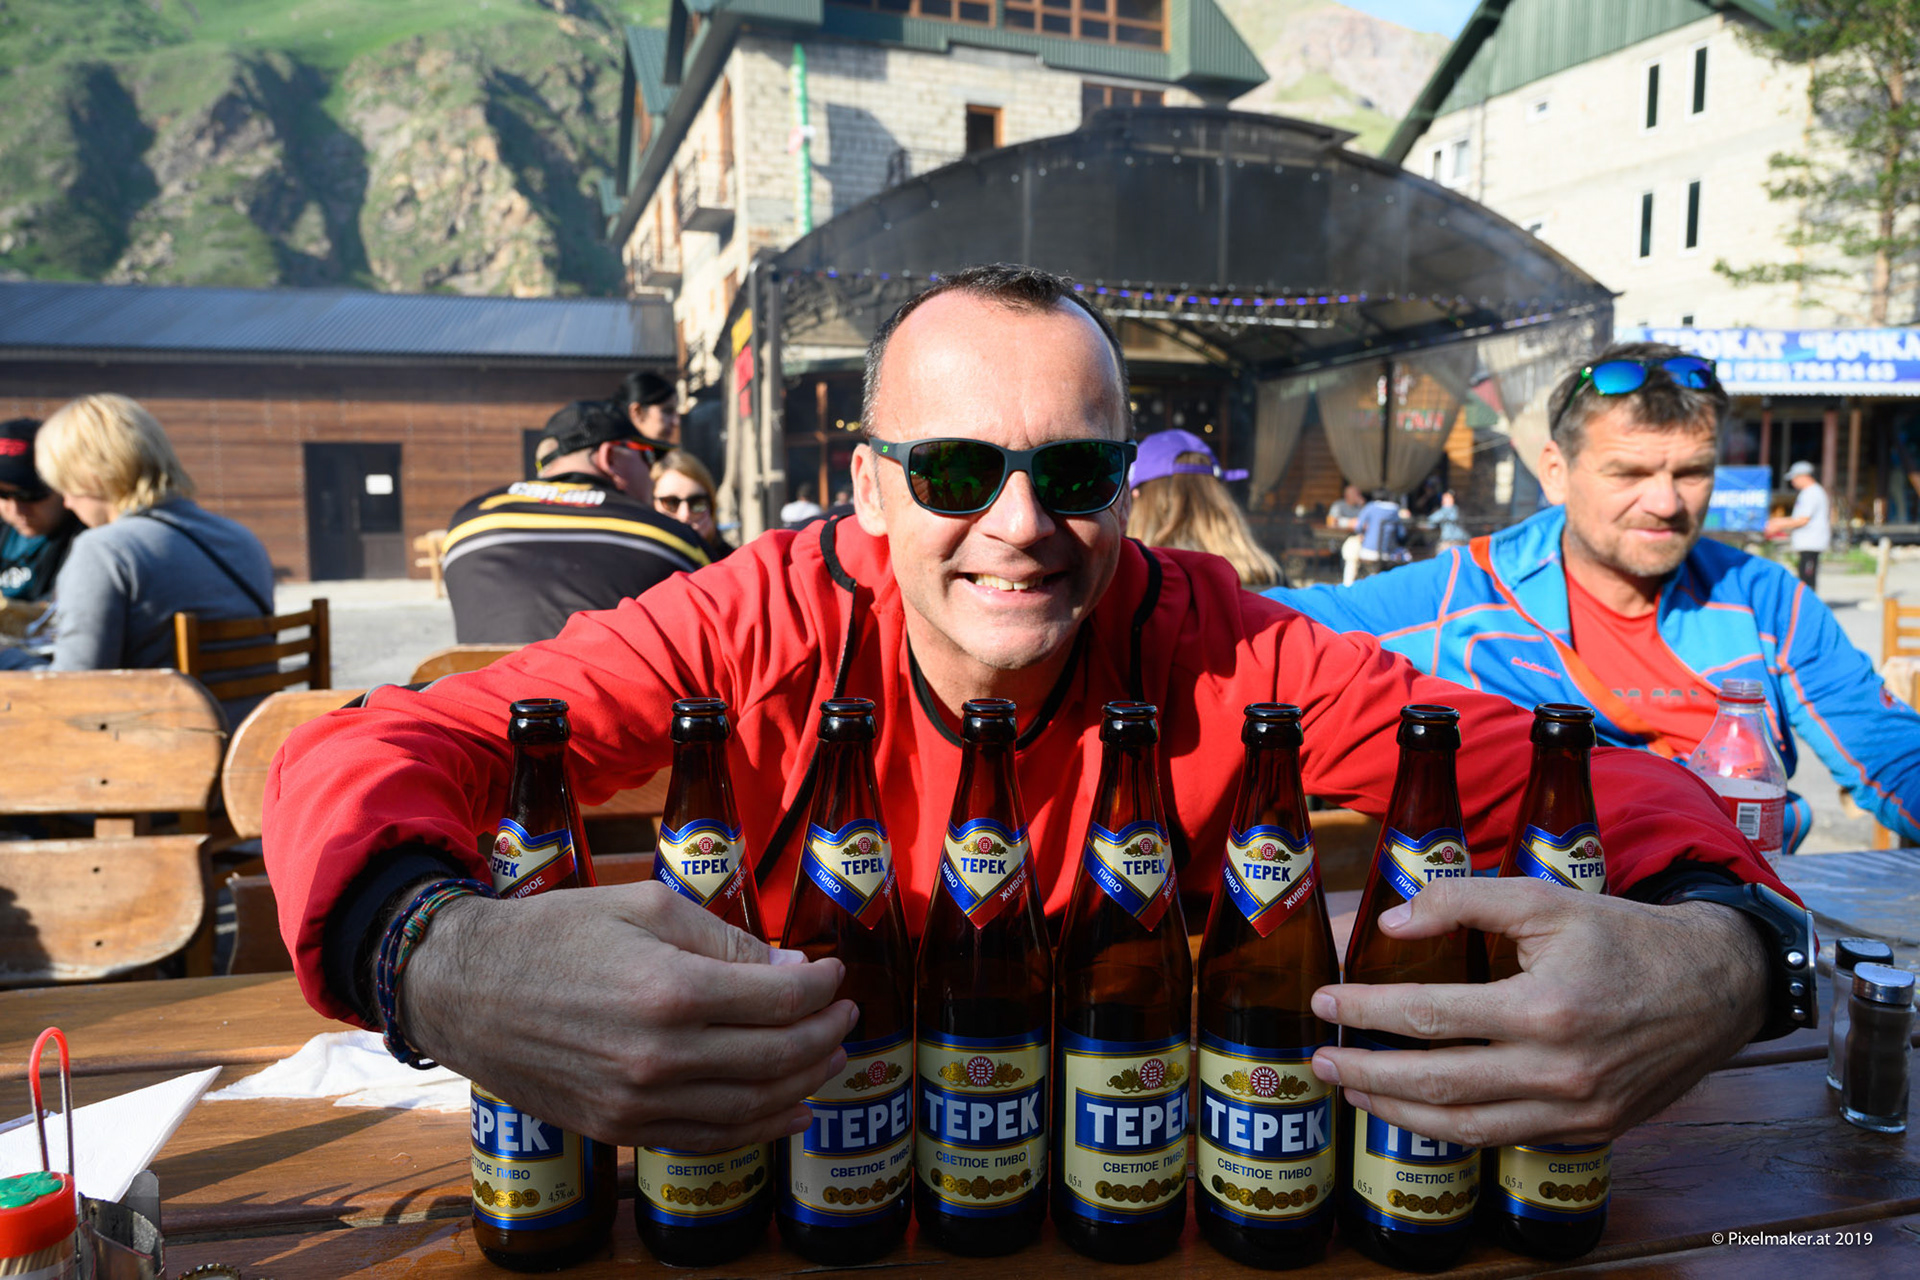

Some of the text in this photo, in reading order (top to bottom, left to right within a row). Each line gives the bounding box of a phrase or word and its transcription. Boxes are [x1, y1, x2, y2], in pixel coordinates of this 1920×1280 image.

[681, 858, 729, 875] ТЕРЕК
[841, 857, 885, 875] ТЕРЕК
[942, 862, 959, 888] ПИВО
[960, 857, 1007, 875] ТЕРЕК
[1122, 858, 1166, 875] ТЕРЕК
[1243, 863, 1292, 882] ТЕРЕК
[660, 867, 680, 892] ПИВО
[724, 866, 748, 899] ЖИВОЕ
[816, 869, 841, 894] ПИВО
[999, 869, 1028, 901] ЖИВОЕ
[1097, 868, 1122, 893] ПИВО
[1224, 867, 1241, 894] ПИВО
[1283, 877, 1313, 910] ЖИВОЕ
[471, 1097, 550, 1152] ЕРЕК
[925, 1089, 1039, 1141] ТЕРЕК
[1086, 1090, 1190, 1146] ТЕРЕК
[1206, 1095, 1326, 1153] ТЕРЕК
[667, 1149, 760, 1176] СВЕТЛОЕ ПИВО
[831, 1144, 910, 1178] СВЕТЛОЕ ПИВО
[936, 1150, 1026, 1168] СВЕТЛОЕ ПИВО
[1103, 1147, 1185, 1174] СВЕТЛОЕ ПИВО
[1217, 1157, 1273, 1180] СВЕТЛОЕ
[1279, 1166, 1313, 1180] ПИВО
[1548, 1159, 1601, 1174] СВЕТЛОЕ
[497, 1167, 530, 1180] ПИВО
[1068, 1173, 1078, 1187] 0,5
[1357, 1179, 1367, 1193] 0,5
[1396, 1170, 1455, 1185] СВЕТЛОЕ
[1504, 1174, 1516, 1188] 0,5
